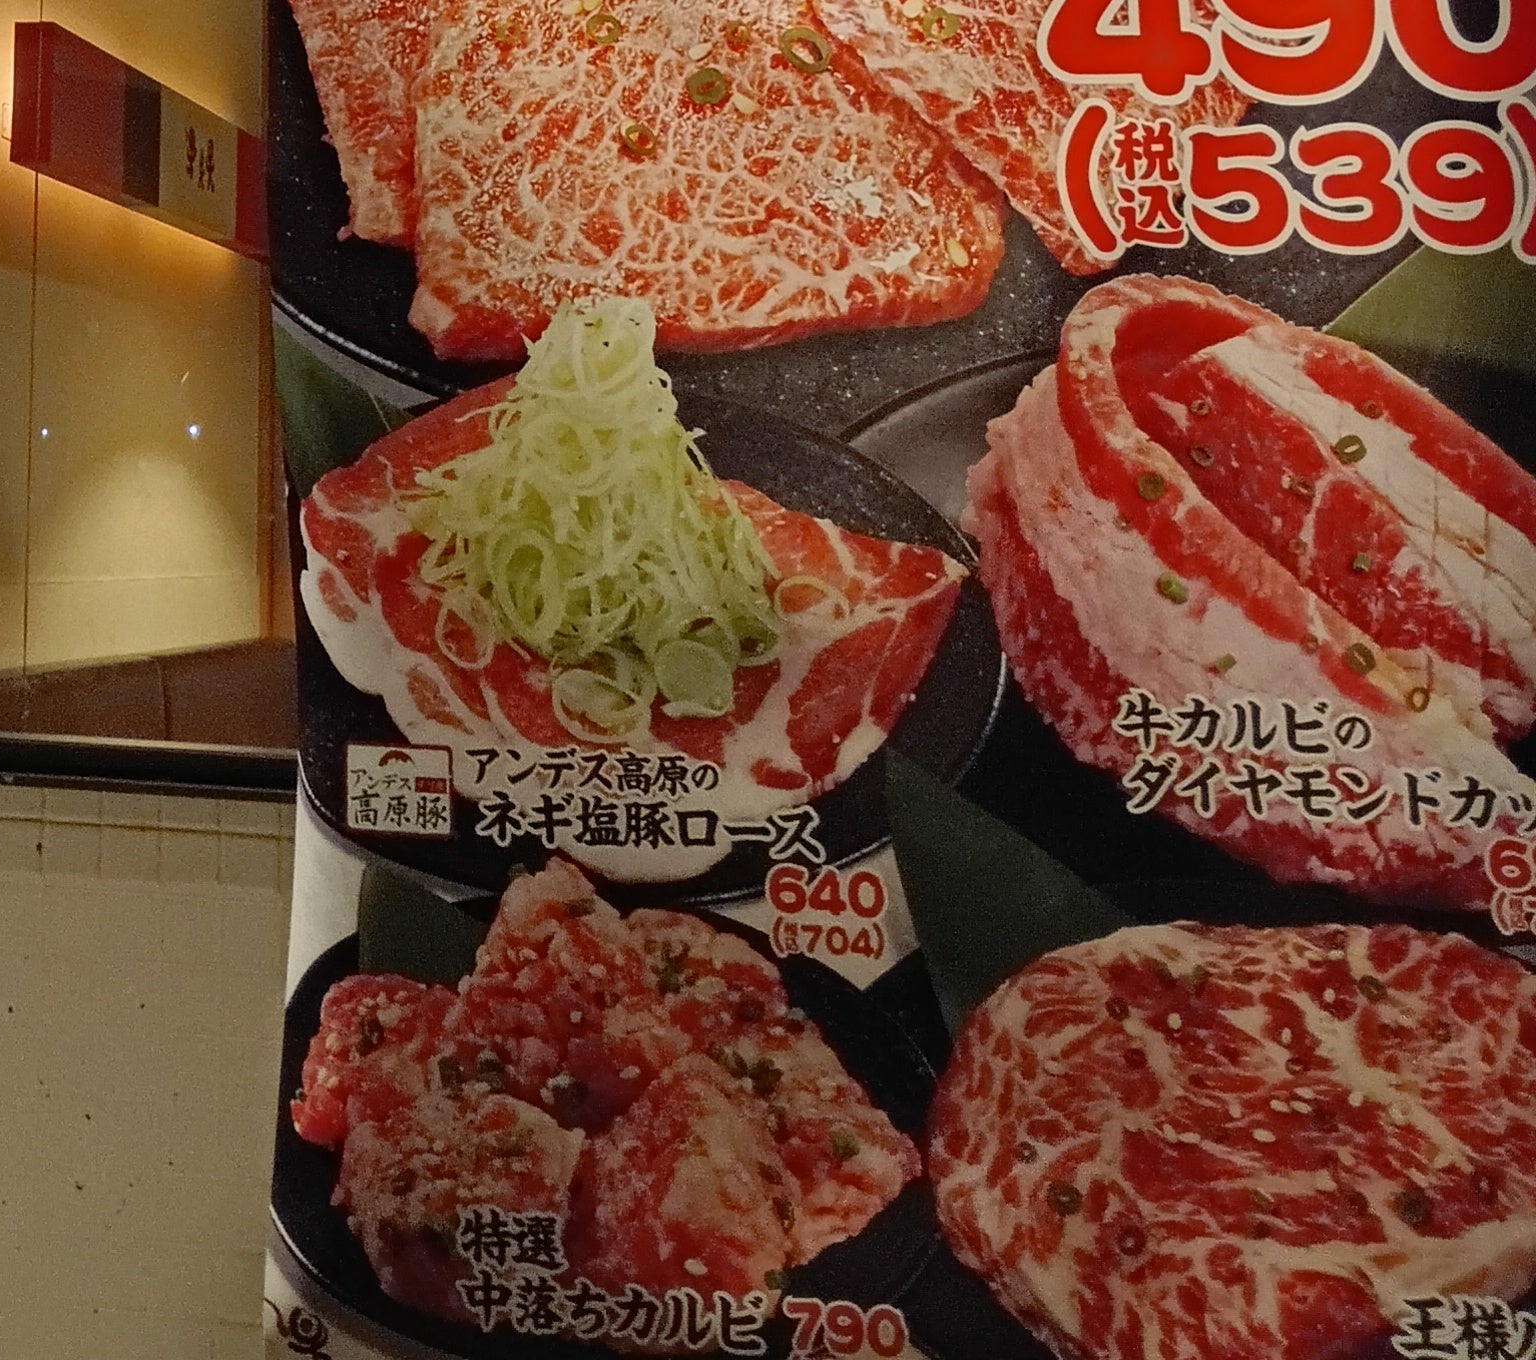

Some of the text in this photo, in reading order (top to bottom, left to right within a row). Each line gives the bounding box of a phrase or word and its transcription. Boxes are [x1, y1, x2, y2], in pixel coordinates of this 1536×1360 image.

[1119, 691, 1370, 755] 牛カルビの
[350, 768, 412, 790] アンデス
[464, 747, 720, 796] アンデス高原の
[350, 788, 448, 830] 高原豚
[481, 790, 824, 862] ネギ塩豚ロース
[768, 866, 885, 919] 640
[460, 1208, 567, 1271] 特選
[462, 1269, 907, 1358] 中落ちカルビ 790
